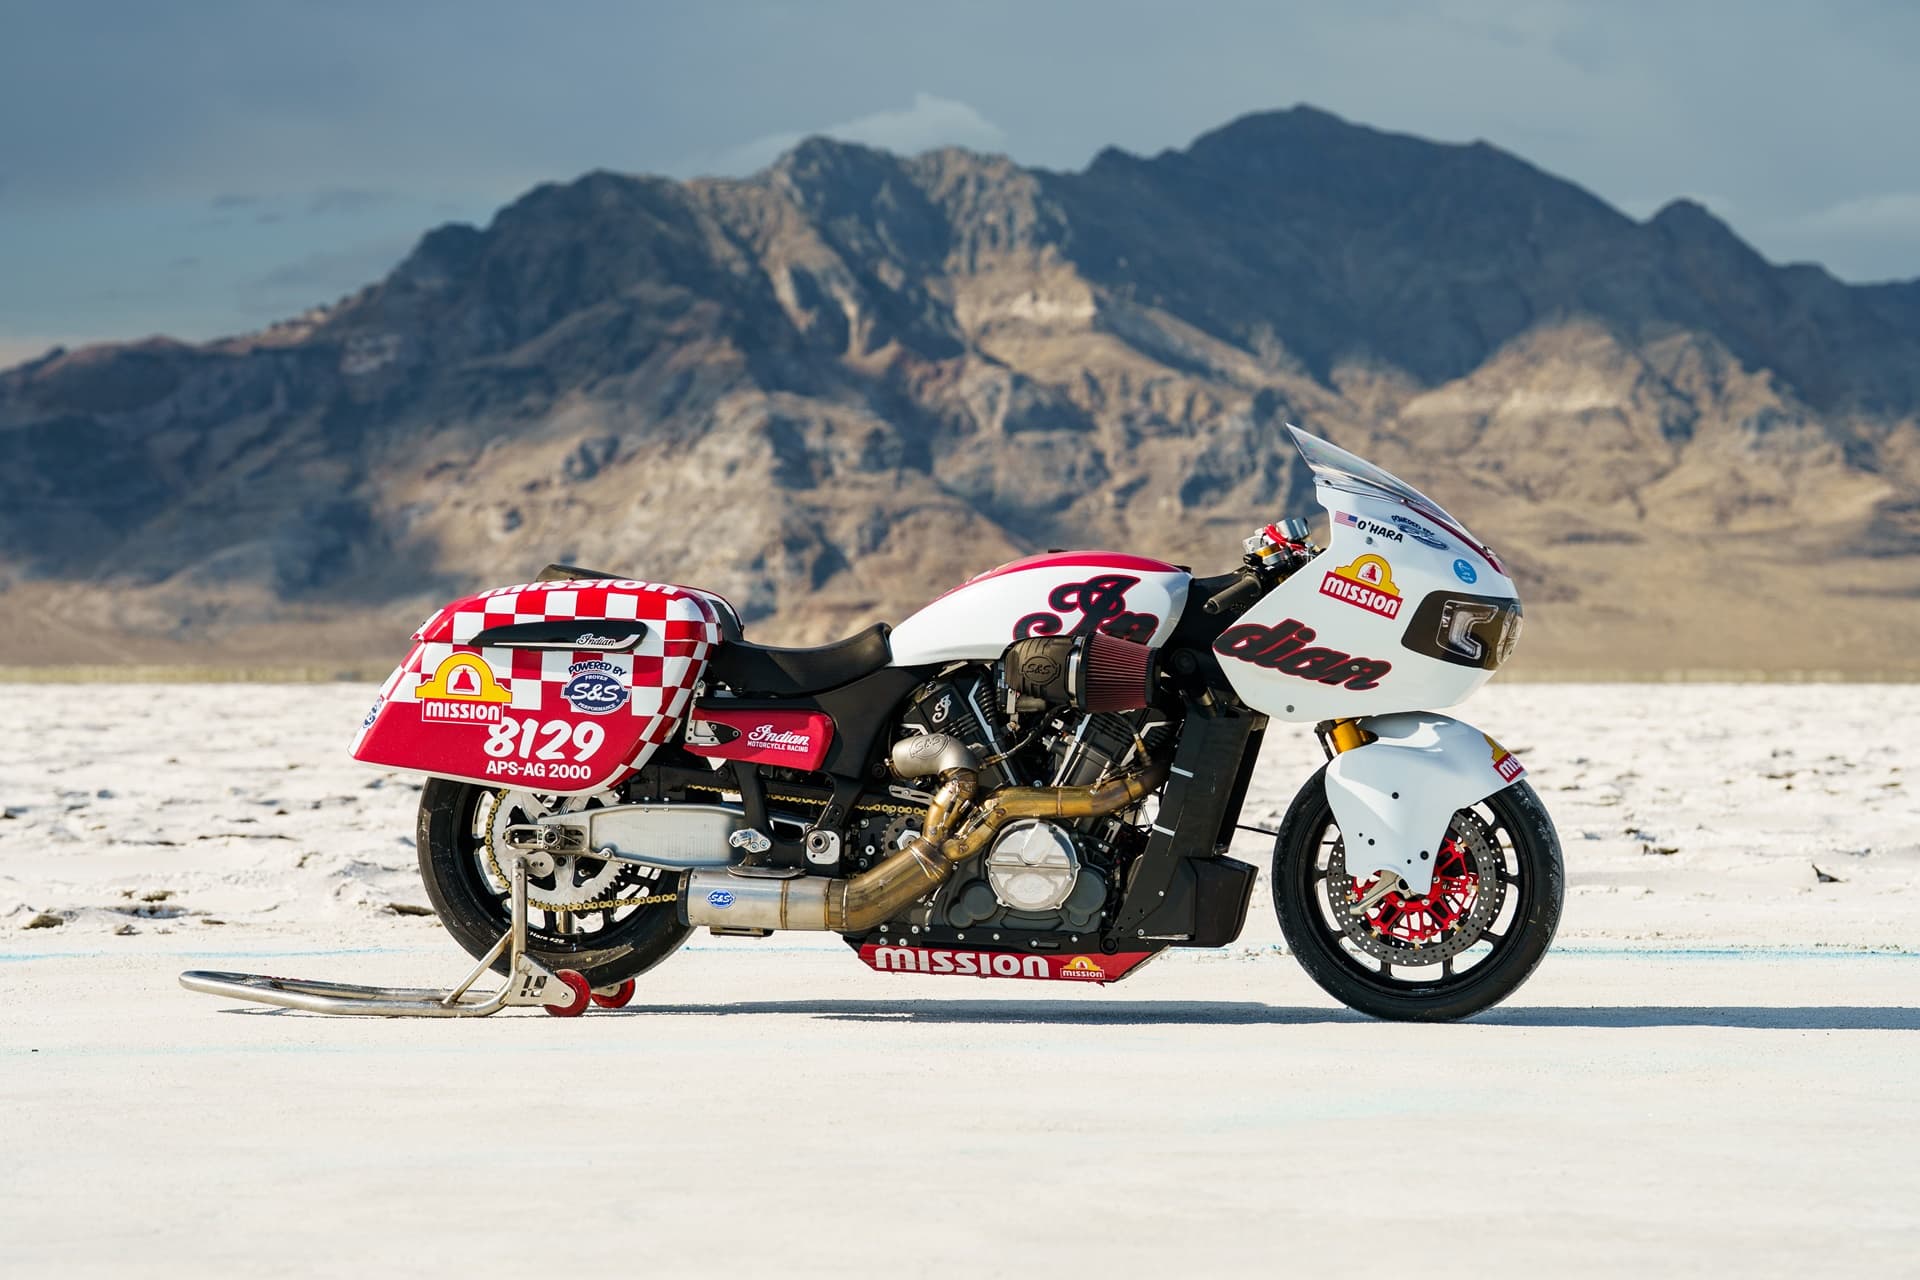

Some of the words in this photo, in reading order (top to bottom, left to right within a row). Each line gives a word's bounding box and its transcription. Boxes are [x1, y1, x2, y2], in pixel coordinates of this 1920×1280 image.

[1357, 520, 1404, 543] O'HARA
[575, 632, 617, 647] Indian
[568, 660, 613, 675] POWERED
[612, 666, 627, 677] BY
[1026, 663, 1051, 675] S&S
[570, 682, 620, 702] S&S
[577, 702, 617, 711] PERFORMANCE
[483, 716, 605, 762] 8129
[747, 724, 811, 746] Indian
[747, 740, 786, 751] MOTORCYCLE
[786, 744, 809, 753] RACING
[486, 760, 546, 777] APS-AG
[548, 764, 592, 780] 2000
[710, 893, 732, 903] S&S
